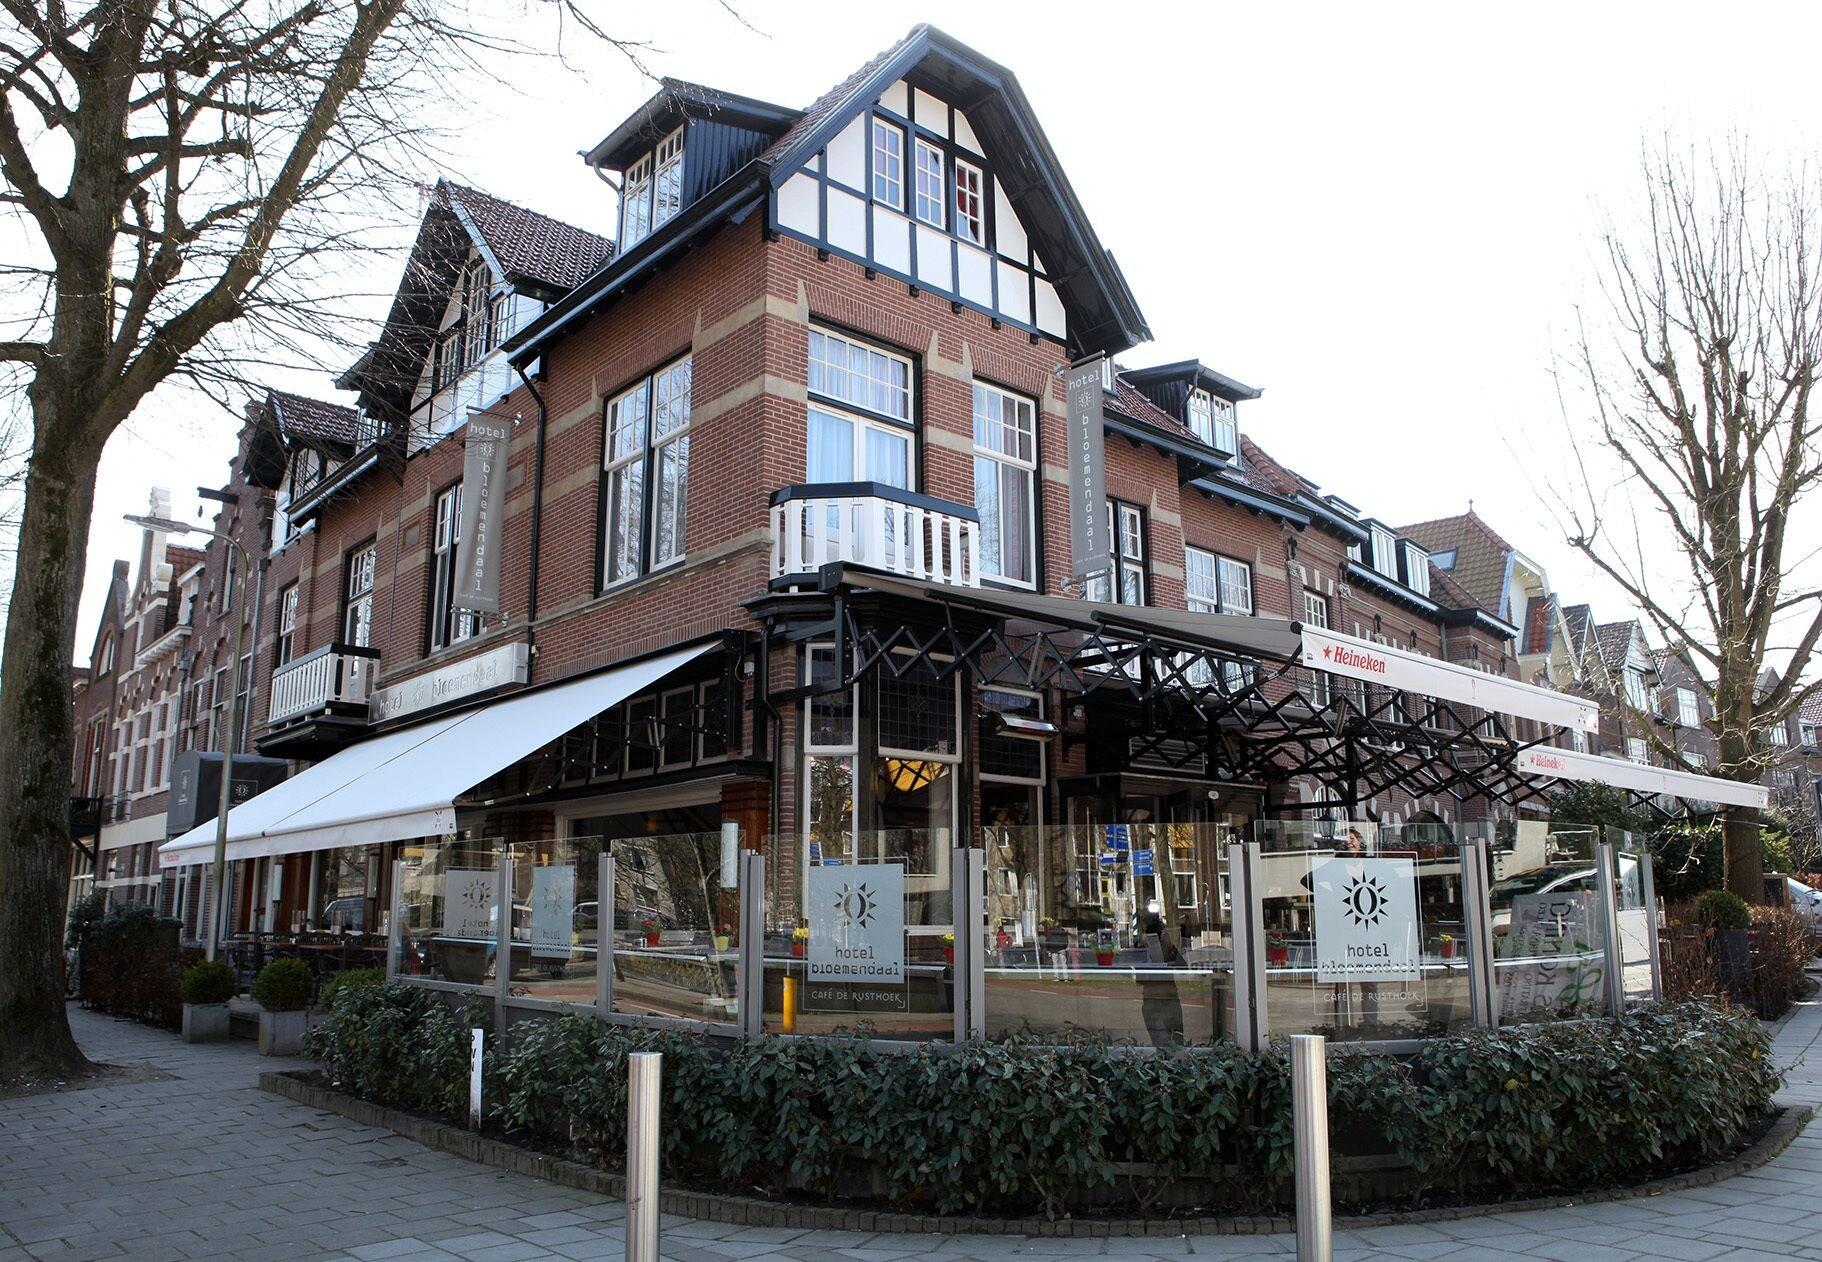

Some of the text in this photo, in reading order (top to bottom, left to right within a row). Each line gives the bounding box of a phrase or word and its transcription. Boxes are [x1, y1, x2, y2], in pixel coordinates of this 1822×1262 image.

[1069, 369, 1100, 390] hotel
[469, 422, 506, 439] hotel
[1081, 414, 1094, 551] bloemendaal
[475, 462, 491, 591] bloemendaal
[1333, 646, 1386, 674] Heineken
[835, 945, 875, 959] hotel
[1347, 943, 1389, 957] hotel
[811, 961, 900, 976] bloemendaal
[1321, 960, 1416, 974] bloemendaal
[811, 987, 906, 1008] CAFÉ DE RUSTHOEK
[1352, 993, 1364, 1001] DE
